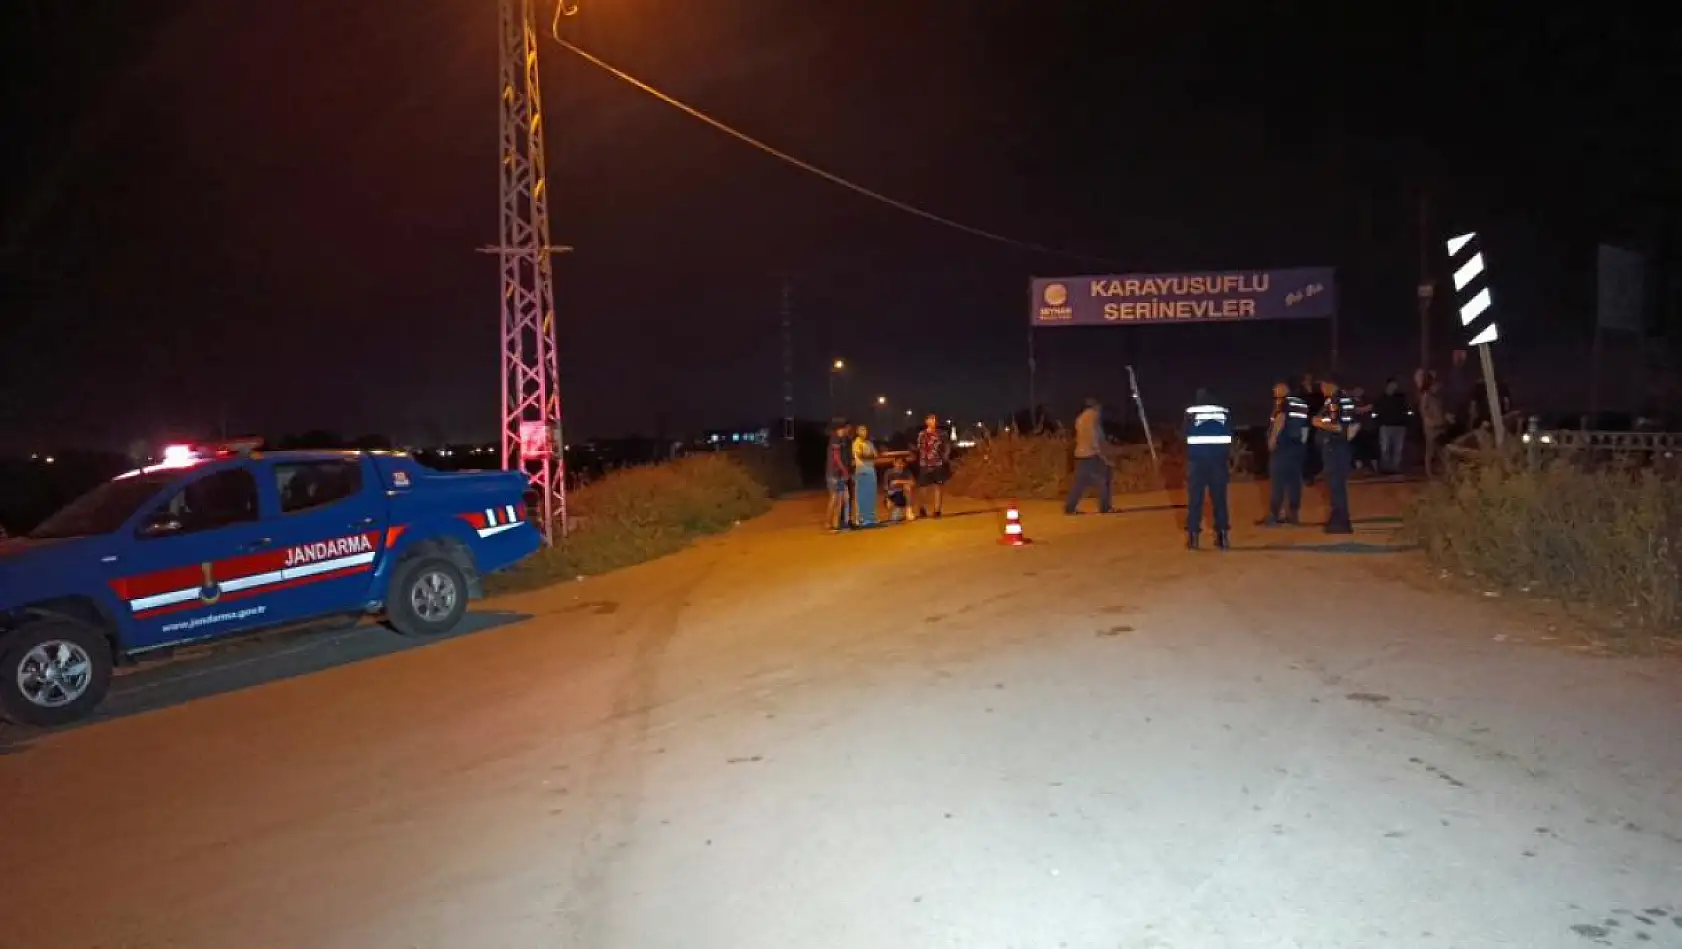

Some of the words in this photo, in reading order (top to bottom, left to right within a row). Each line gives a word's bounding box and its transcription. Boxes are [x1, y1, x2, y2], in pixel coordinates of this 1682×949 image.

[1090, 274, 1270, 297] KARAYUSUFLU
[1104, 298, 1256, 321] SERİNEVLER
[284, 533, 373, 566] JANDARMA
[162, 605, 267, 632] www.jandarma.gov.tr
